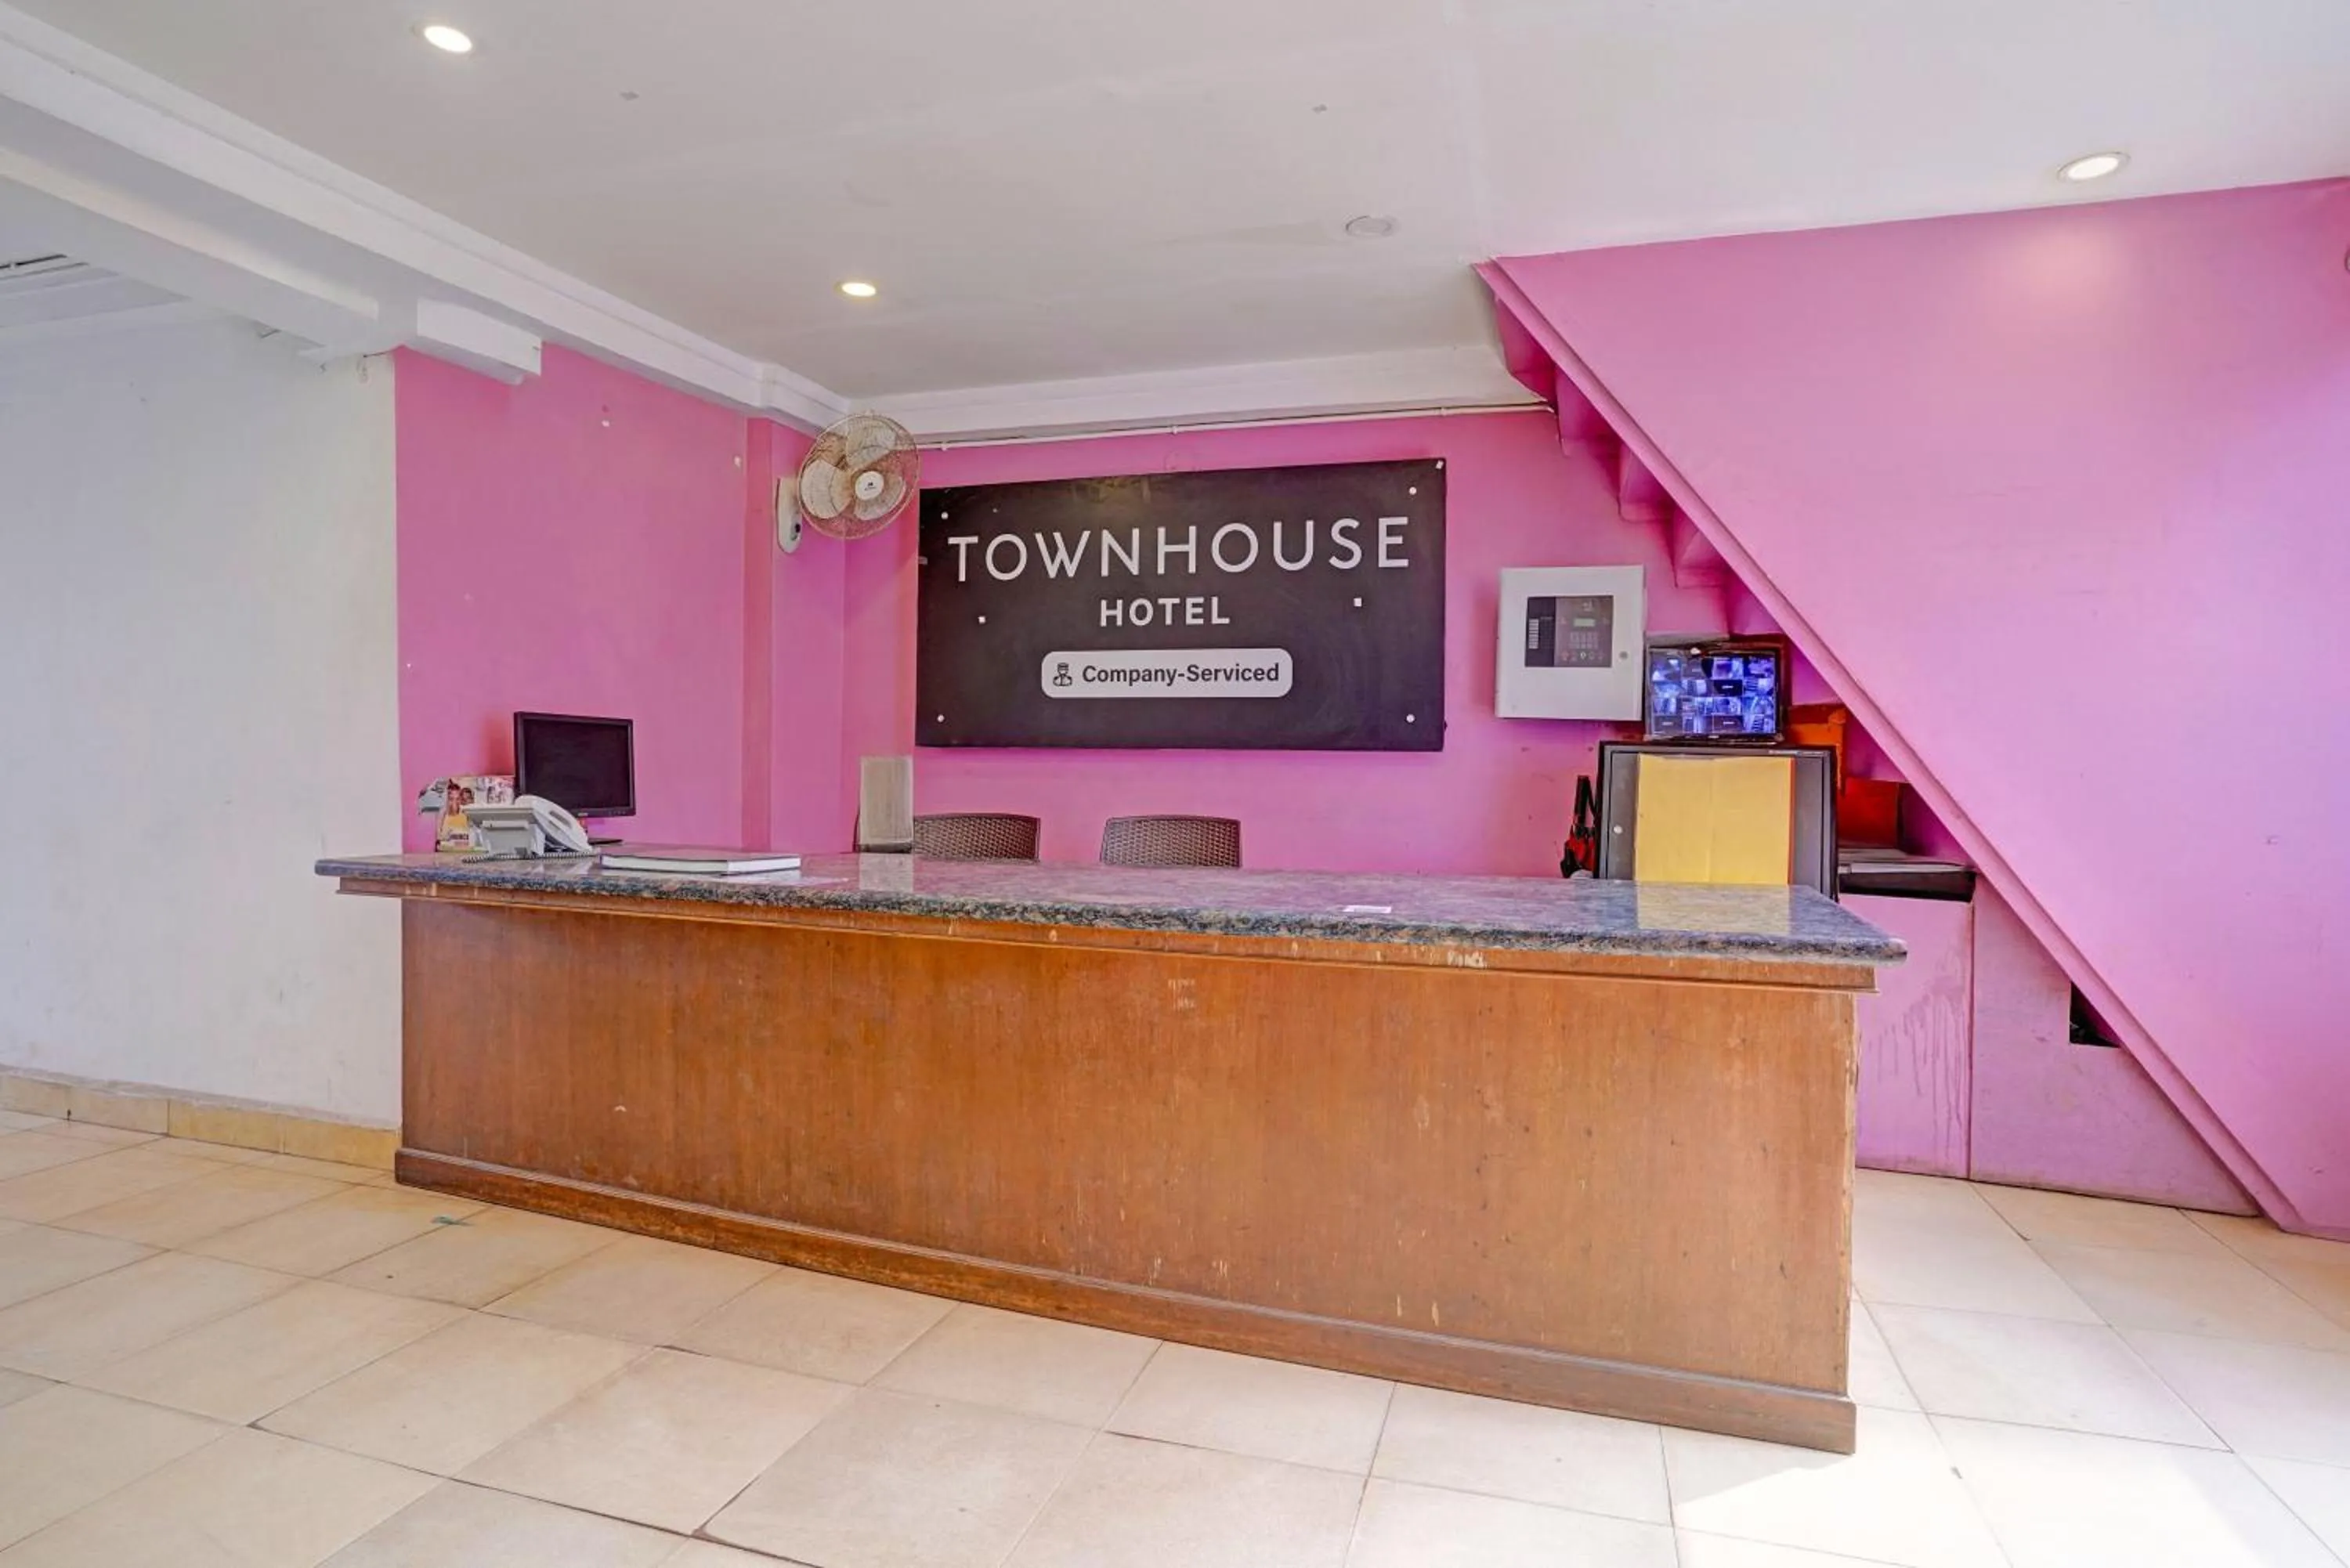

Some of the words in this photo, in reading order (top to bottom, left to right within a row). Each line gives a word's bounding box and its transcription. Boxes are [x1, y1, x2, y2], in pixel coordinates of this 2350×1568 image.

[947, 516, 1409, 582] TOWNHOUSE
[1100, 596, 1231, 627] HOTEL
[1082, 662, 1279, 687] Company-Serviced
